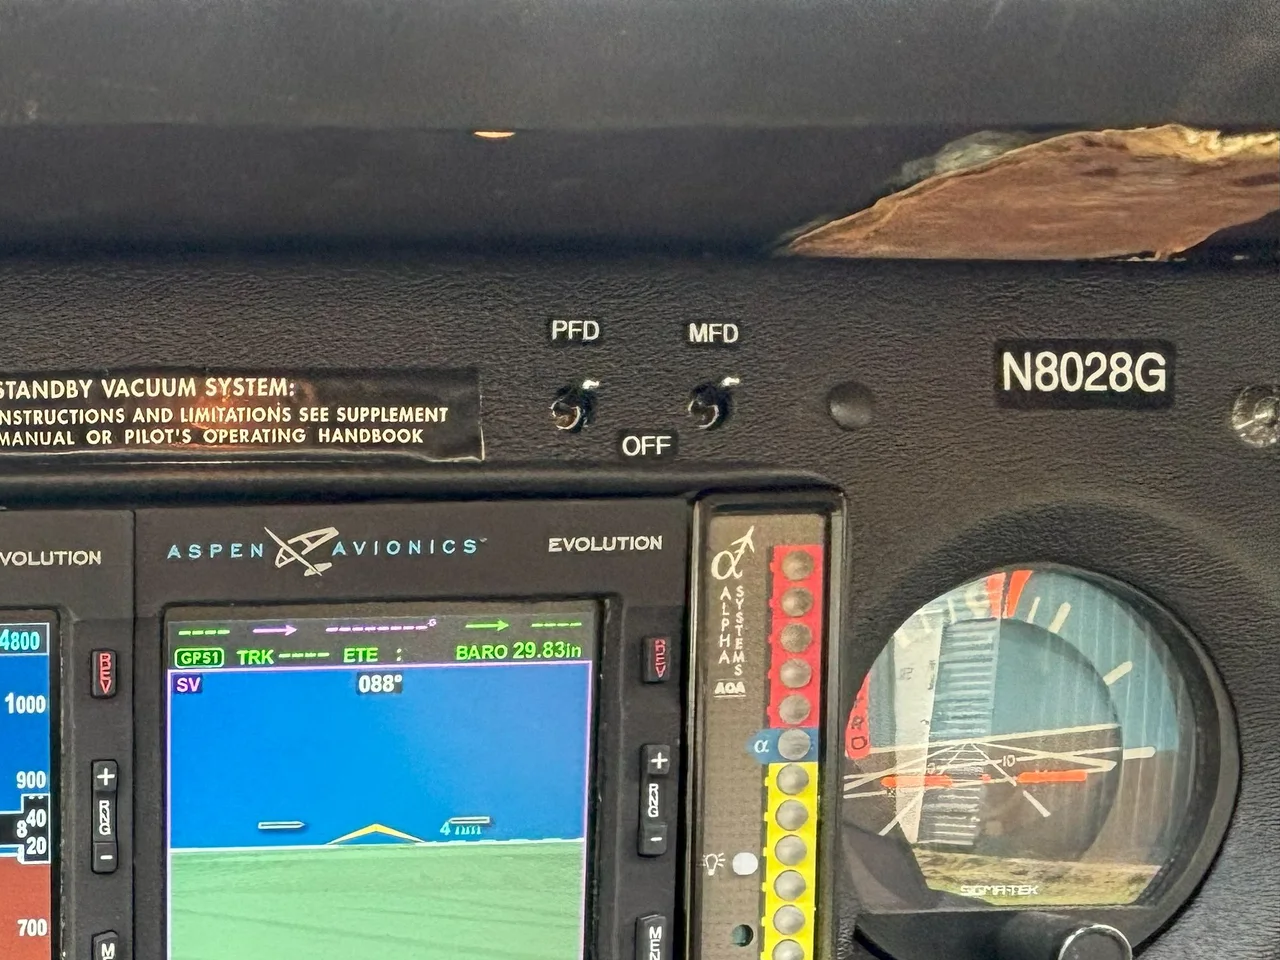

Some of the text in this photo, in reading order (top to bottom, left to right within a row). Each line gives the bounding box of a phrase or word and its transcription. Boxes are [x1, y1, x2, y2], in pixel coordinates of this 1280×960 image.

[551, 319, 600, 341] PFD
[688, 323, 739, 345] MFD
[1002, 351, 1167, 393] N8028G
[100, 377, 197, 399] VACUUM
[205, 376, 296, 398] SYSTEM:
[132, 407, 174, 424] AND
[180, 406, 292, 423] LIMITATIONS
[298, 406, 329, 423] SEE
[336, 406, 449, 423] SUPPLEMENT
[85, 429, 112, 445] OR
[124, 428, 192, 445] PILOT'S
[202, 428, 307, 444] OPERATING
[318, 428, 424, 443] HANDBOOK
[622, 434, 672, 456] OFF
[166, 538, 480, 560] ASPEN AVIONICS
[548, 535, 664, 553] EVOLUTION
[718, 585, 732, 665] ALPHA
[733, 584, 746, 677] SYSTEMS
[180, 651, 219, 665] GPS1
[236, 650, 275, 665] TRK
[343, 647, 379, 663] ETE
[456, 645, 508, 661] BARO
[176, 677, 200, 693] SV
[5, 692, 46, 714] 1000
[17, 919, 48, 936] 700
